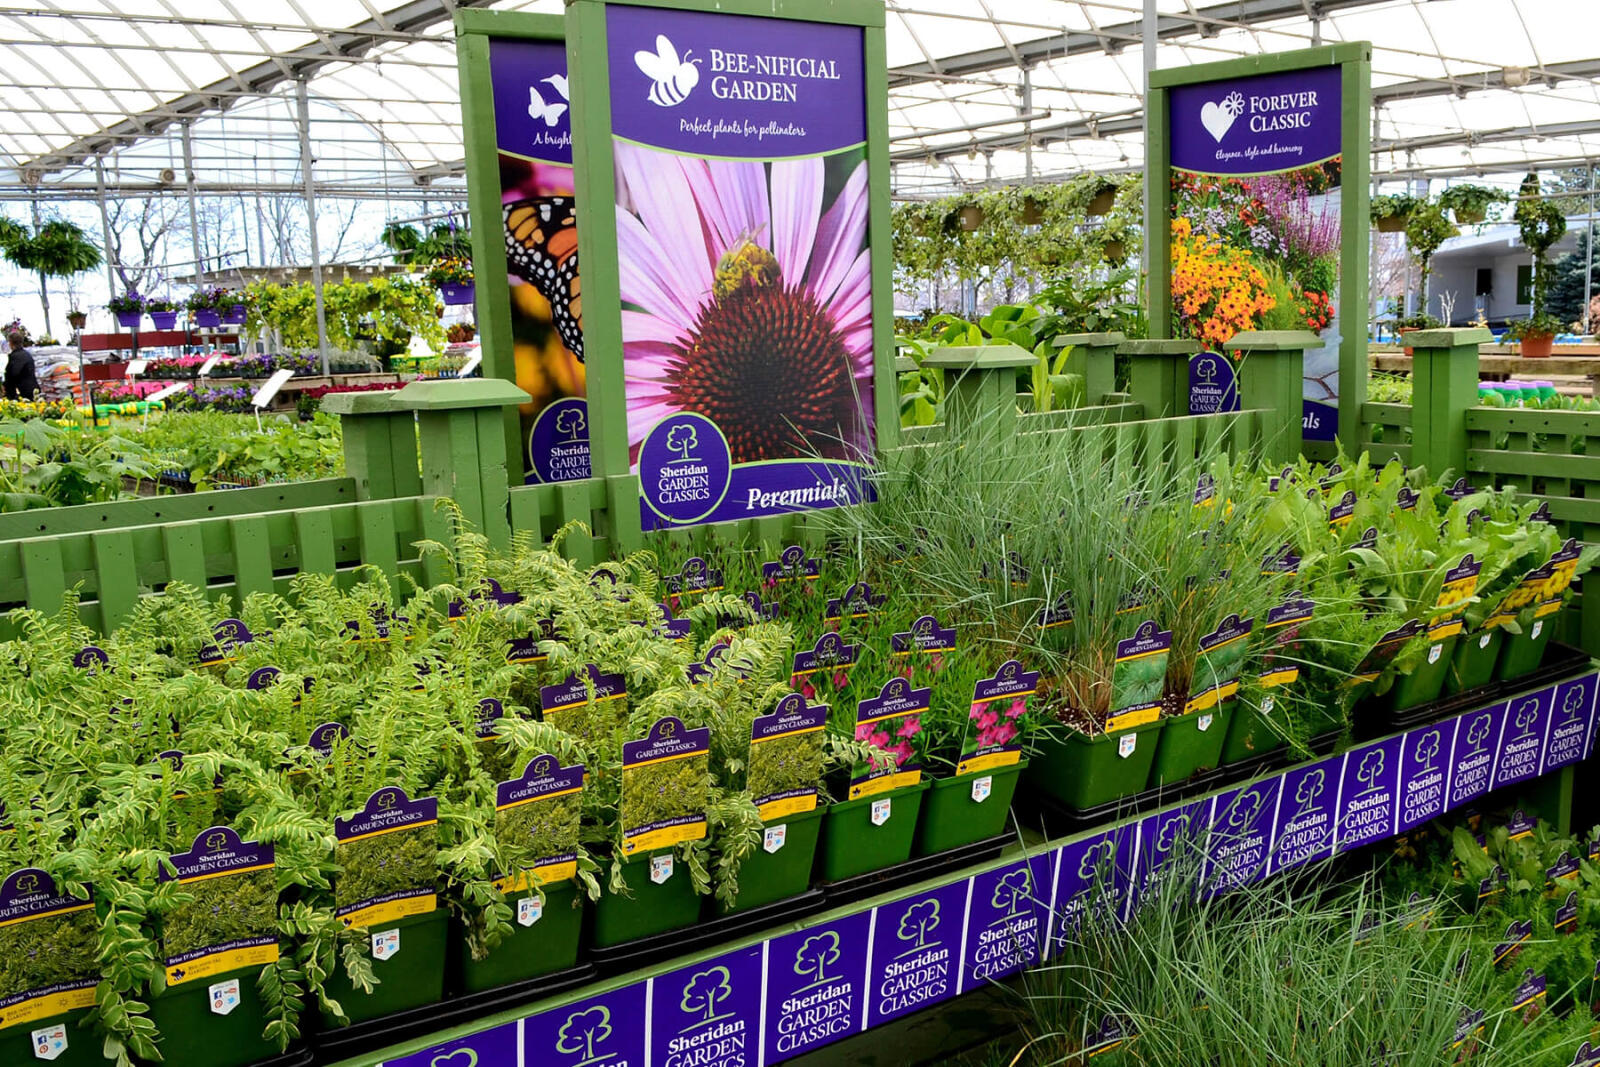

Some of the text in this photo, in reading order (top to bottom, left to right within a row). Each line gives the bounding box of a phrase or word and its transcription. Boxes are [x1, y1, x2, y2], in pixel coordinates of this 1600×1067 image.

[710, 48, 841, 80] BEE-NIFICIAL
[711, 75, 798, 103] GARDEN
[1250, 91, 1318, 113] FOREVER
[680, 118, 806, 140] Perfect plants for pollinators
[1250, 112, 1311, 132] CLASSIC
[532, 132, 544, 146] A
[1260, 145, 1273, 155] and
[1190, 394, 1222, 404] GARDEN
[1192, 386, 1222, 395] Sheridan
[551, 445, 590, 456] Sherida
[550, 467, 592, 480] CLASSIC
[660, 465, 708, 478] Sheridan
[658, 475, 709, 492] GARDEN
[746, 477, 847, 510] Perennials
[658, 488, 710, 504] CLASSICS
[983, 682, 1028, 696] GARDEN CLASSICS
[868, 699, 921, 716] GARDEN CLASSICS
[883, 697, 907, 706] Sheridan
[763, 718, 816, 734] GARDEN CLASSICS
[778, 714, 802, 724] Sheridan
[1553, 723, 1585, 740] Sheridan
[635, 740, 697, 760] GARDEN CLASSICS
[652, 738, 681, 749] Sheridan
[1505, 737, 1540, 755] Sheridan
[1550, 732, 1583, 753] GARDEN
[1457, 753, 1491, 773] Sheridan
[1501, 748, 1538, 770] GARDEN
[1547, 746, 1581, 767] CLASSICS
[527, 777, 555, 788] Sheridan
[1407, 771, 1442, 793] Sheridan
[1454, 763, 1490, 788] GARDEN
[1498, 762, 1535, 783] CLASSICS
[509, 779, 571, 800] GARDEN CLASSICS
[1405, 783, 1442, 809] GARDEN
[1452, 778, 1487, 802] CLASSICS
[1347, 793, 1390, 813] Sheridan
[1404, 799, 1440, 824] CLASSICS
[350, 811, 423, 833] GARDEN CLASSICS
[370, 809, 403, 821] Sheridan
[1284, 813, 1328, 833] Sheridan
[1345, 803, 1390, 829] GARDEN
[1280, 824, 1328, 851] GARDEN
[1344, 819, 1389, 844] CLASSICS
[177, 854, 259, 876] GARDEN CLASSICS
[199, 851, 236, 864] Sheridan
[0, 895, 76, 918] RDEN CLASSICS
[9, 893, 50, 907] Sheridan
[979, 917, 1038, 946] Sheridan
[208, 942, 237, 953] Variegated
[255, 936, 275, 944] Ladder
[975, 929, 1038, 964] GARDEN
[884, 948, 949, 980] Sheridan
[973, 948, 1036, 980] CLASSICS
[880, 960, 949, 998] GARDEN
[780, 982, 852, 1017] Sheridan
[879, 979, 947, 1016] CLASSICS
[777, 995, 853, 1036] GARDEN
[667, 1019, 746, 1056] Sheridan
[776, 1014, 851, 1053] CLASSICS
[664, 1033, 746, 1067] GARDEN
